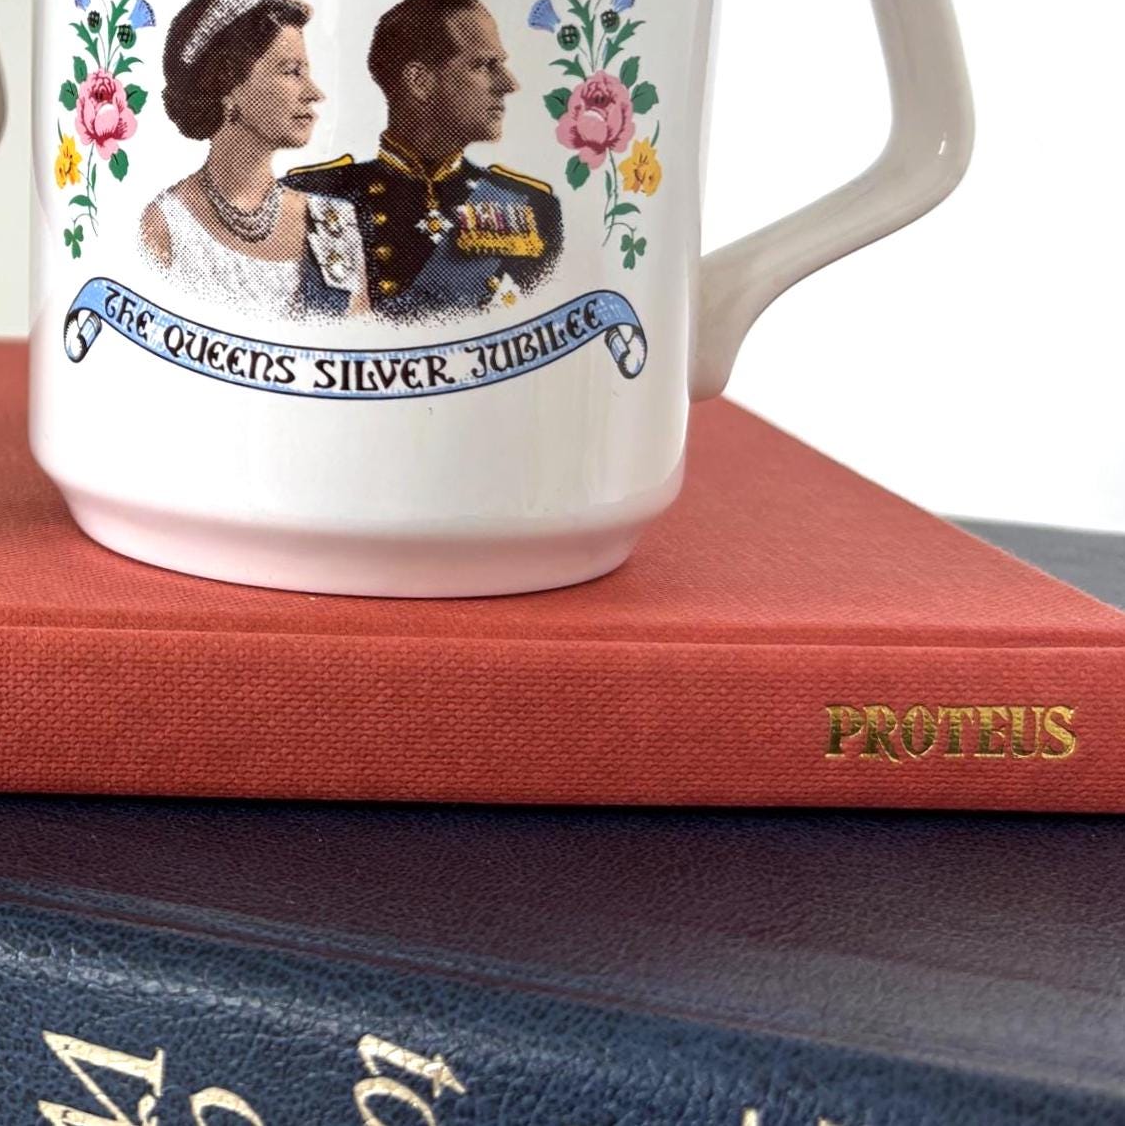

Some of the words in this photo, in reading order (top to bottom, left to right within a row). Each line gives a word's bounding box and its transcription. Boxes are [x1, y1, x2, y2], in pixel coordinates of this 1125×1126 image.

[163, 324, 296, 385] QUEENS
[313, 355, 455, 392] SILVER
[464, 298, 603, 379] JUBILEE
[824, 703, 1077, 763] PROTEUS
